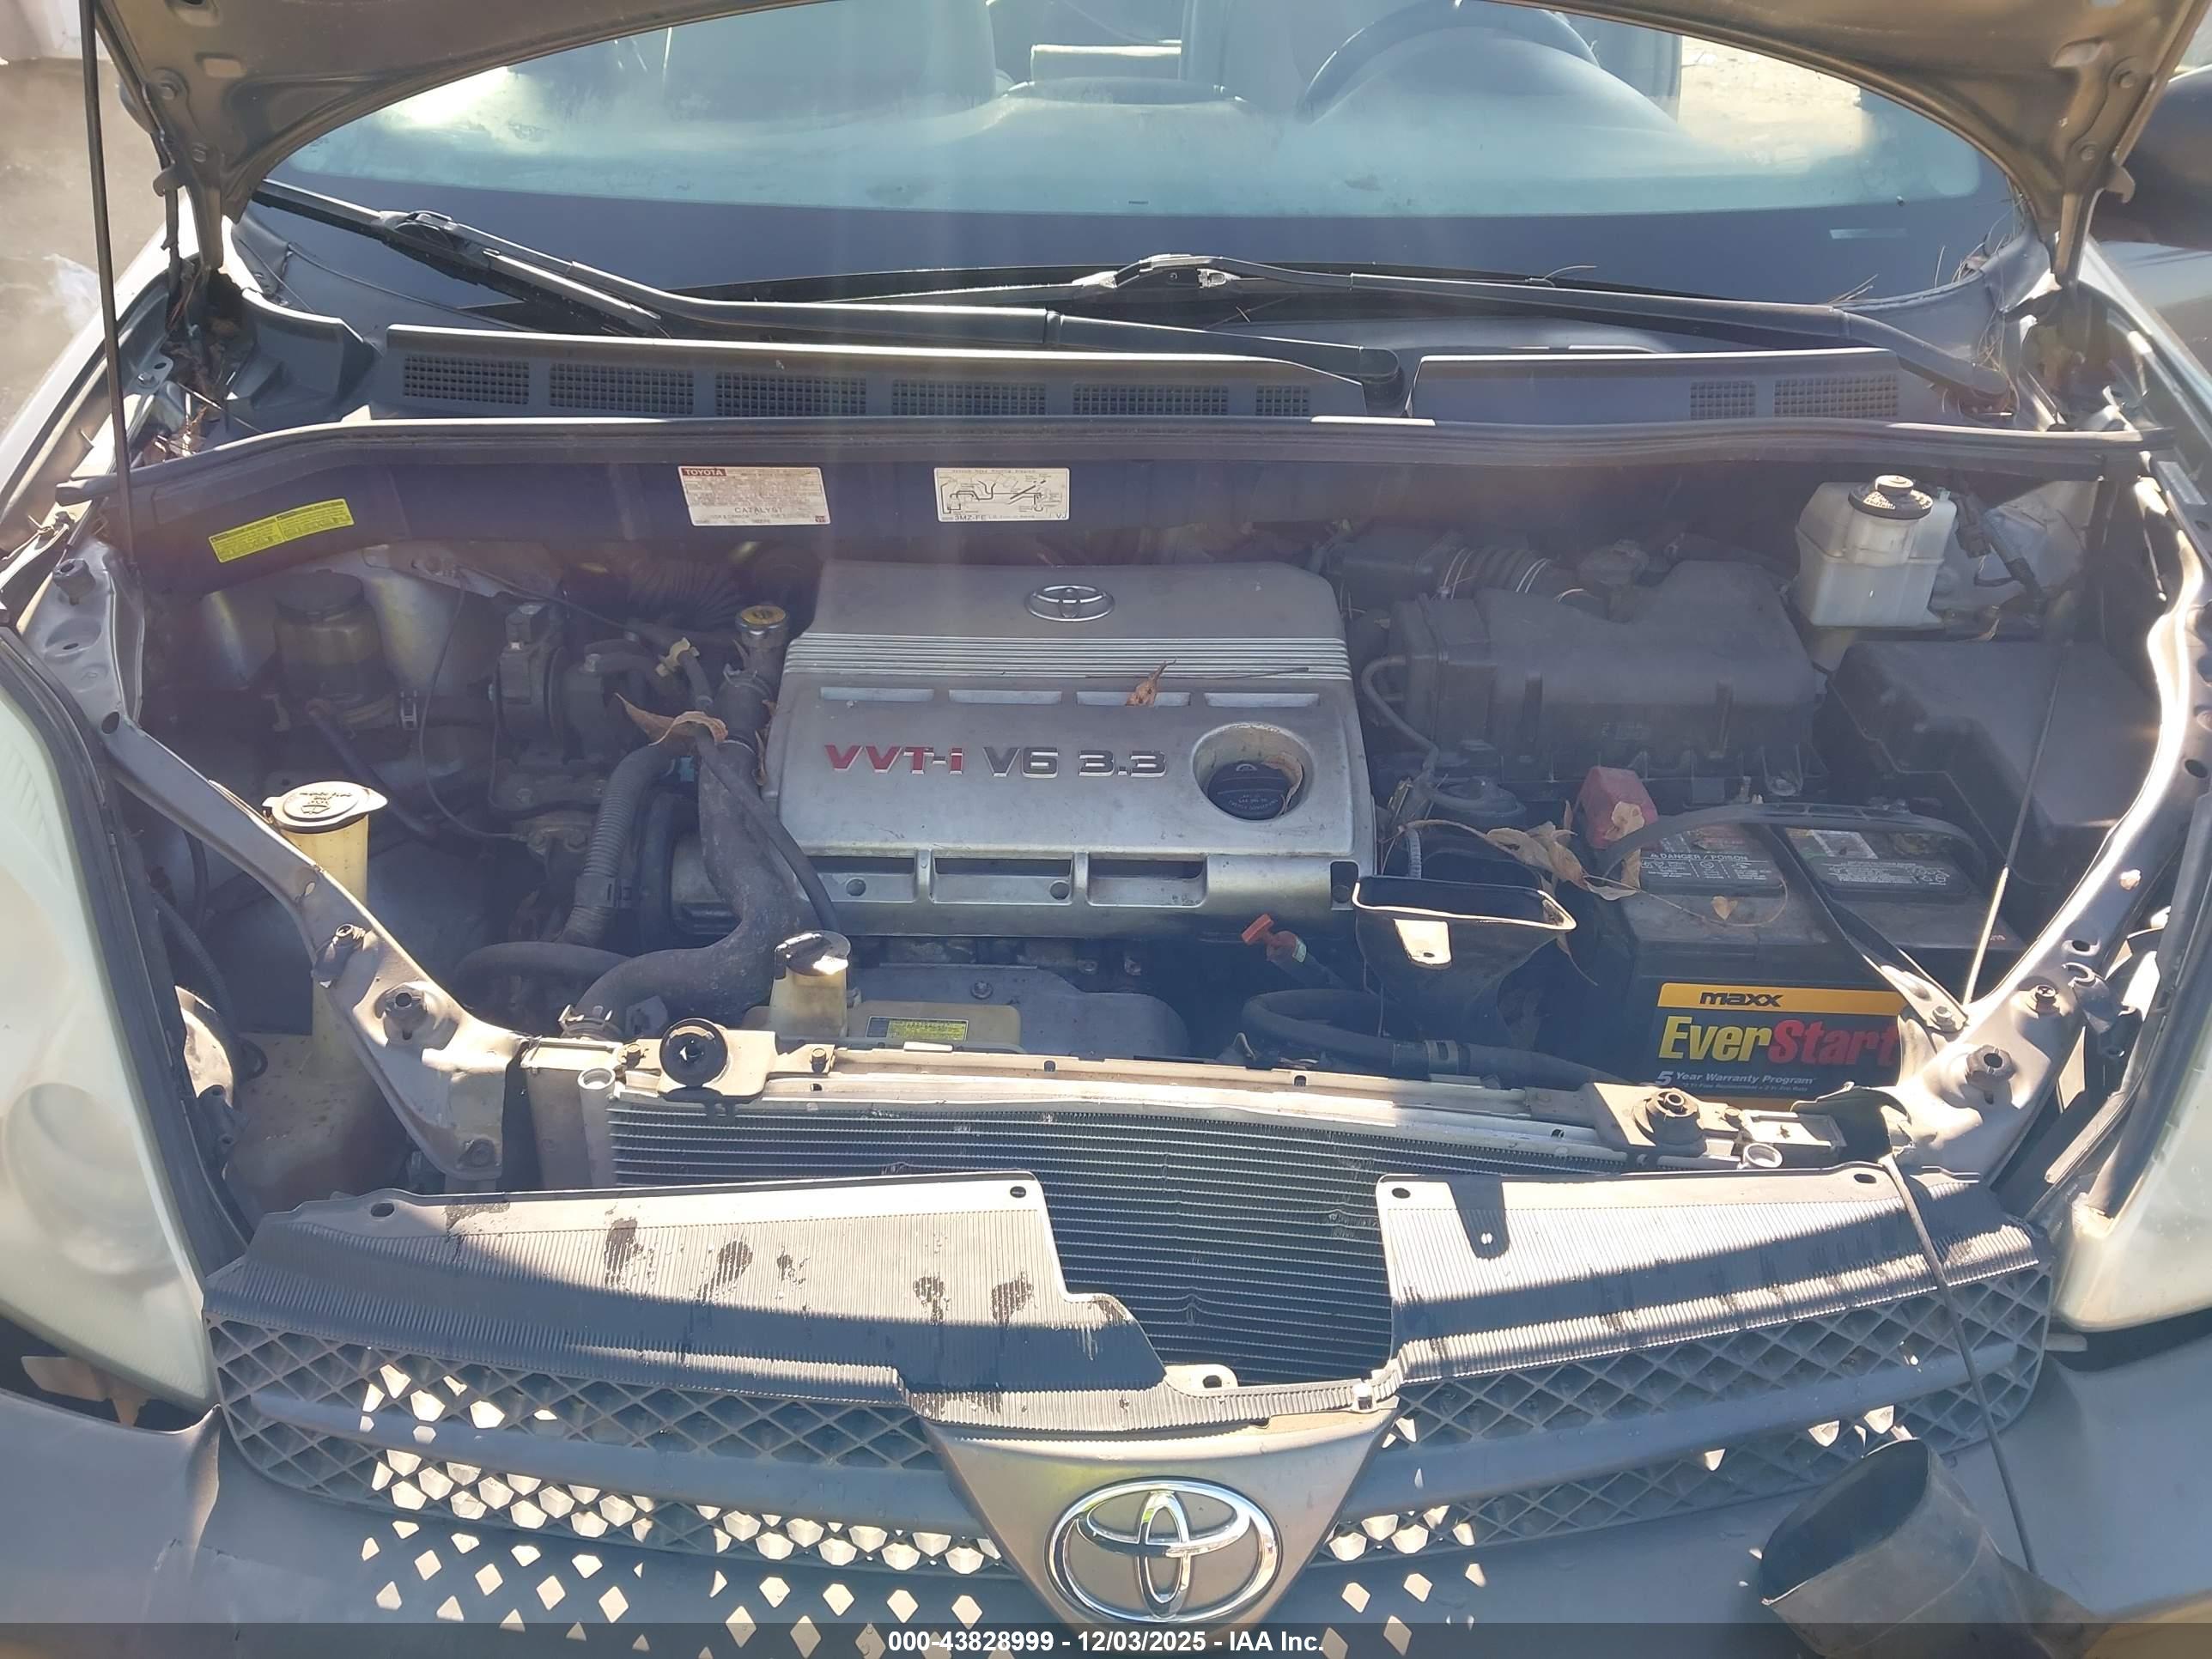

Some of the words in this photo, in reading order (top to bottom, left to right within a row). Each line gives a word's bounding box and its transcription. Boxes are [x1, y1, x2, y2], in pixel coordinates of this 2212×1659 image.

[685, 468, 724, 477] TOYOTA
[824, 744, 963, 775] VVT-i
[983, 747, 1060, 779] V6
[1079, 750, 1167, 777] 3.3
[1699, 992, 1784, 1007] maxx
[1658, 1015, 1899, 1066] EverStart
[1656, 1071, 1674, 1086] 5
[1675, 1072, 1704, 1081] Year
[1705, 1073, 1759, 1085] Warranty
[1762, 1074, 1814, 1086] Program
